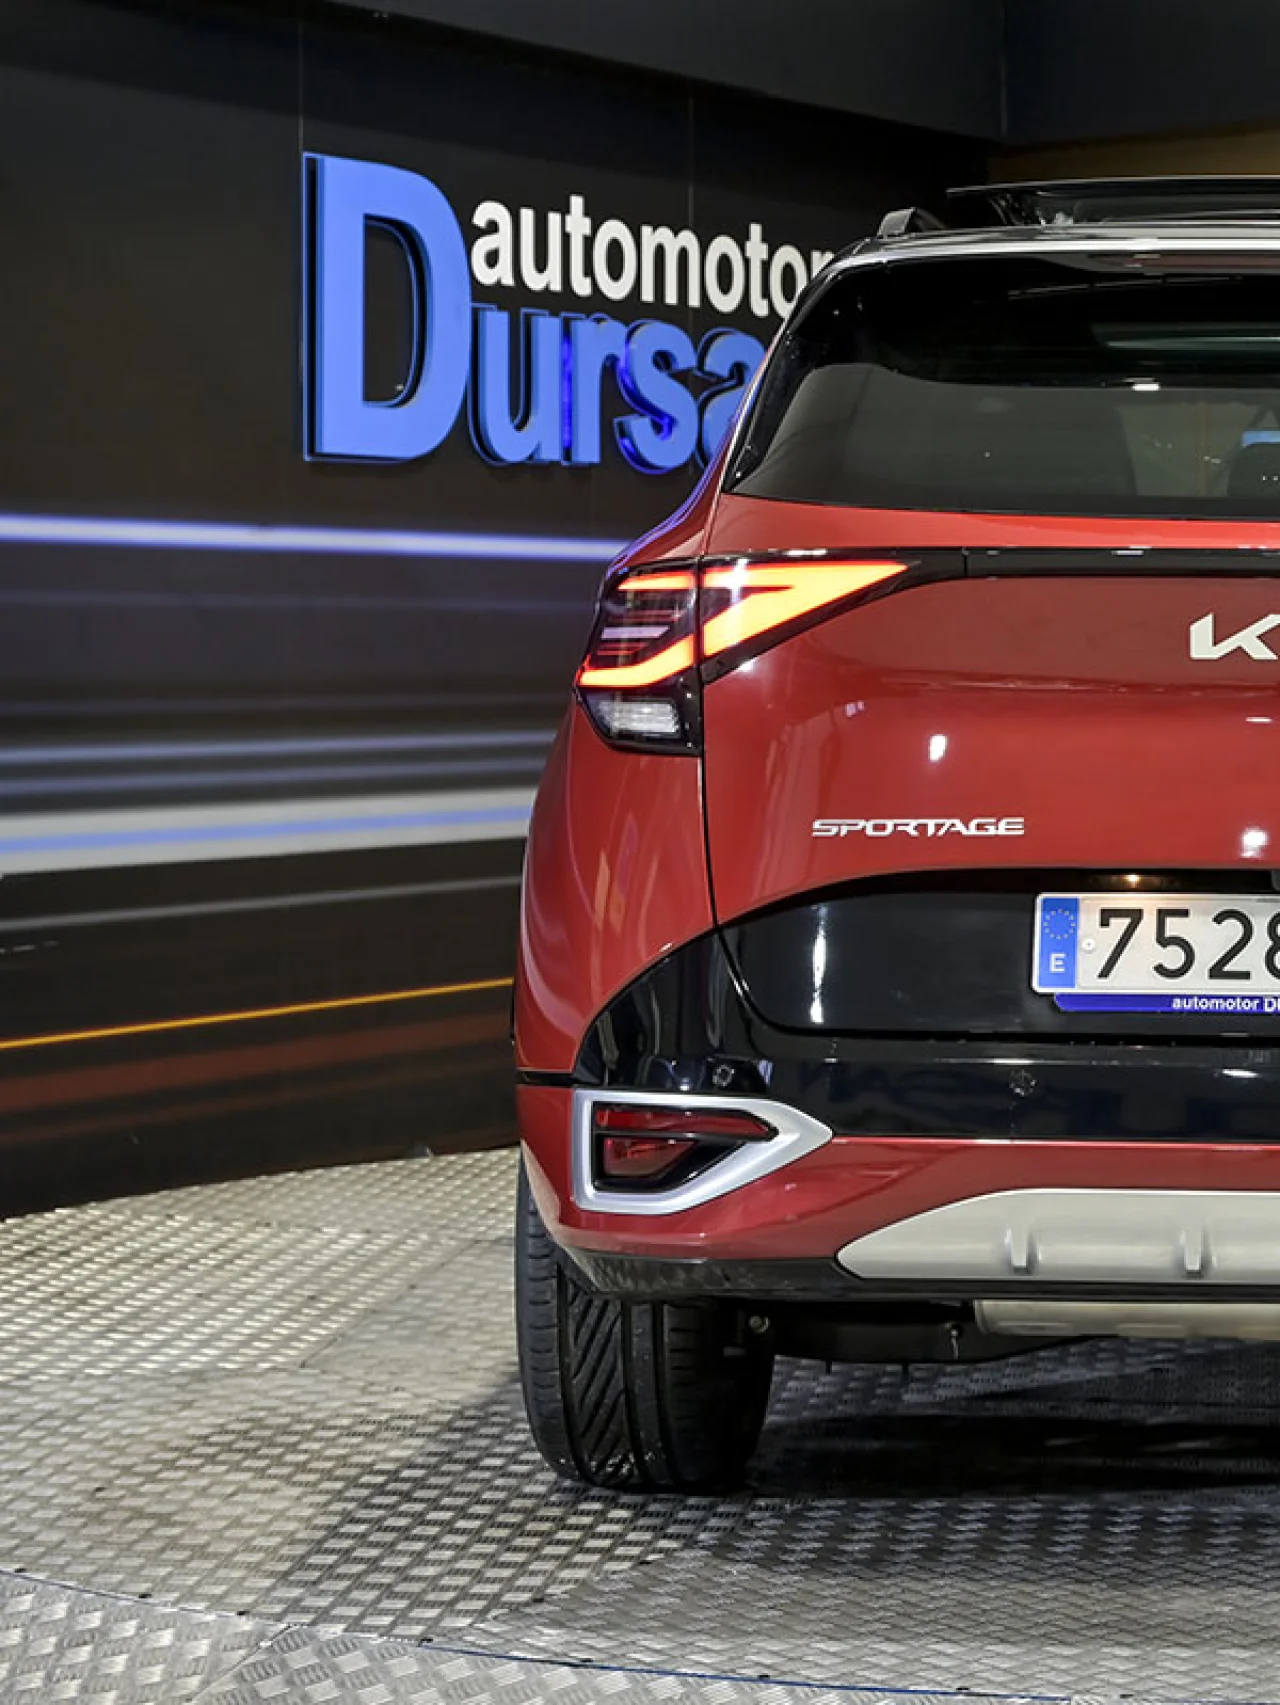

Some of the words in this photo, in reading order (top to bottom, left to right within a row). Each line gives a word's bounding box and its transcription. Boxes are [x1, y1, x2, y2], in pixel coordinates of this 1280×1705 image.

[811, 816, 1025, 837] SPORTAGE
[1049, 953, 1066, 974] E
[1171, 996, 1260, 1011] automotor
